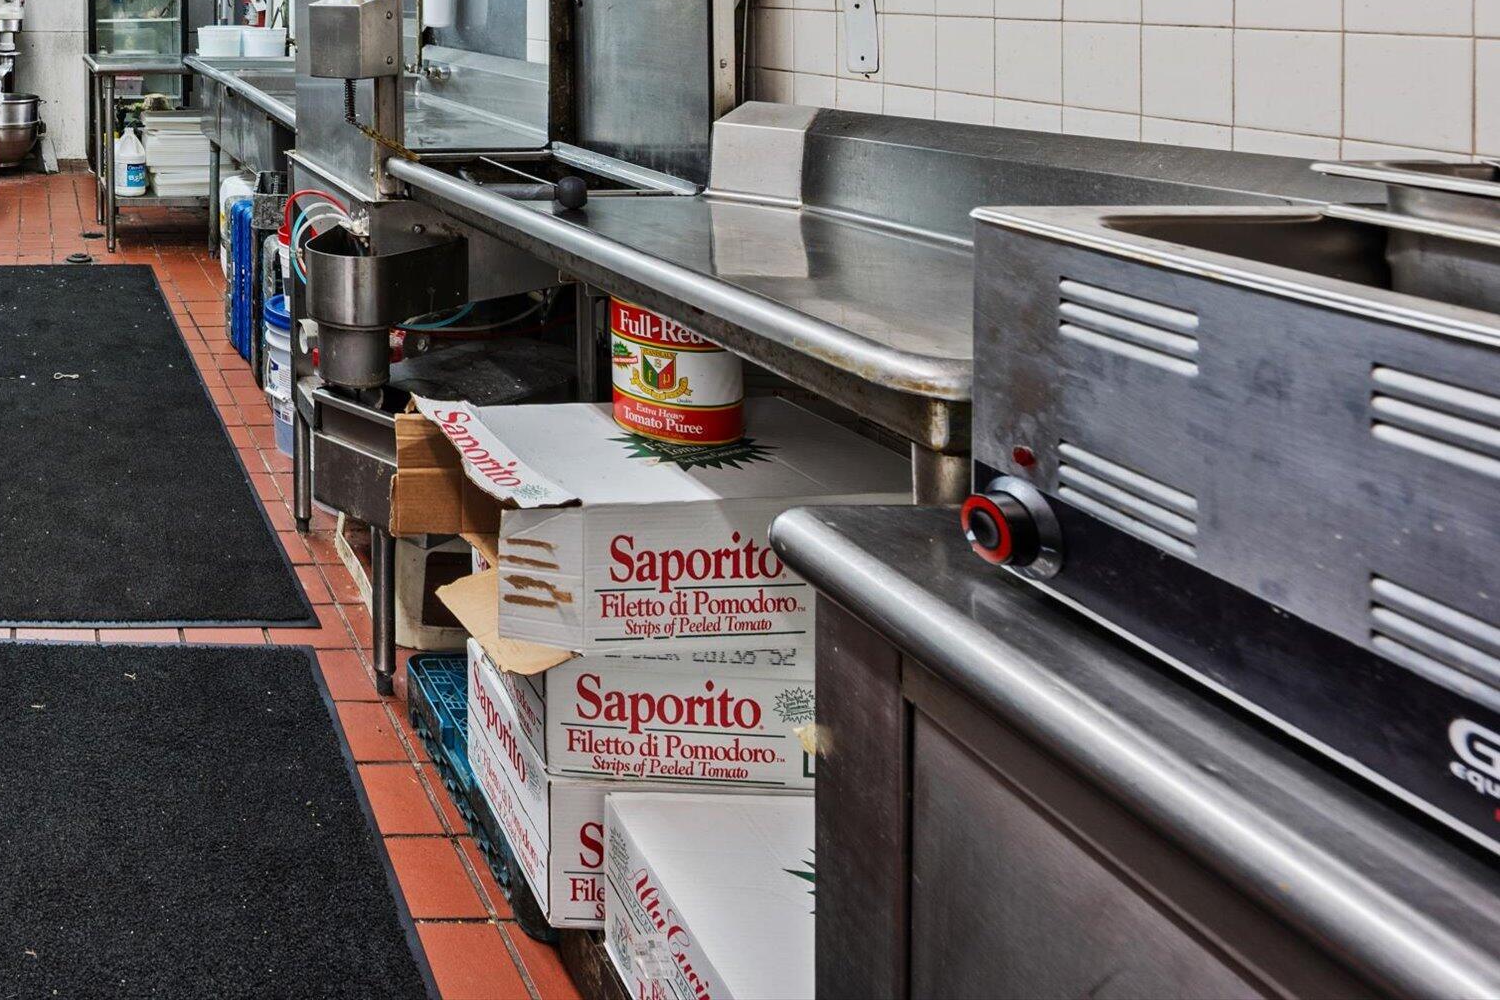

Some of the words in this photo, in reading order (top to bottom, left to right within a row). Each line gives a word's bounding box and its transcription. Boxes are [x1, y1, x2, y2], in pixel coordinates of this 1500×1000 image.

[623, 405, 663, 429] Tomato
[665, 418, 704, 435] Puree
[636, 402, 657, 417] Extra
[658, 408, 686, 422] Heavy
[434, 409, 522, 487] Saporito
[609, 531, 784, 593] Saporito
[600, 593, 665, 618] Filetto
[669, 591, 688, 617] di
[693, 589, 798, 616] Pomodoro
[625, 619, 661, 637] Strips
[664, 618, 677, 637] of
[680, 617, 721, 633] Peeled
[725, 616, 772, 631] Tomato
[576, 673, 762, 734] Saporito
[472, 661, 527, 784] Saporito
[566, 728, 635, 757] Filetto
[639, 733, 658, 757] di
[664, 735, 776, 764] Pomodoro
[592, 756, 630, 777] Strips
[633, 758, 648, 778] of
[650, 759, 694, 776] Peeled
[698, 761, 749, 779] Tomato
